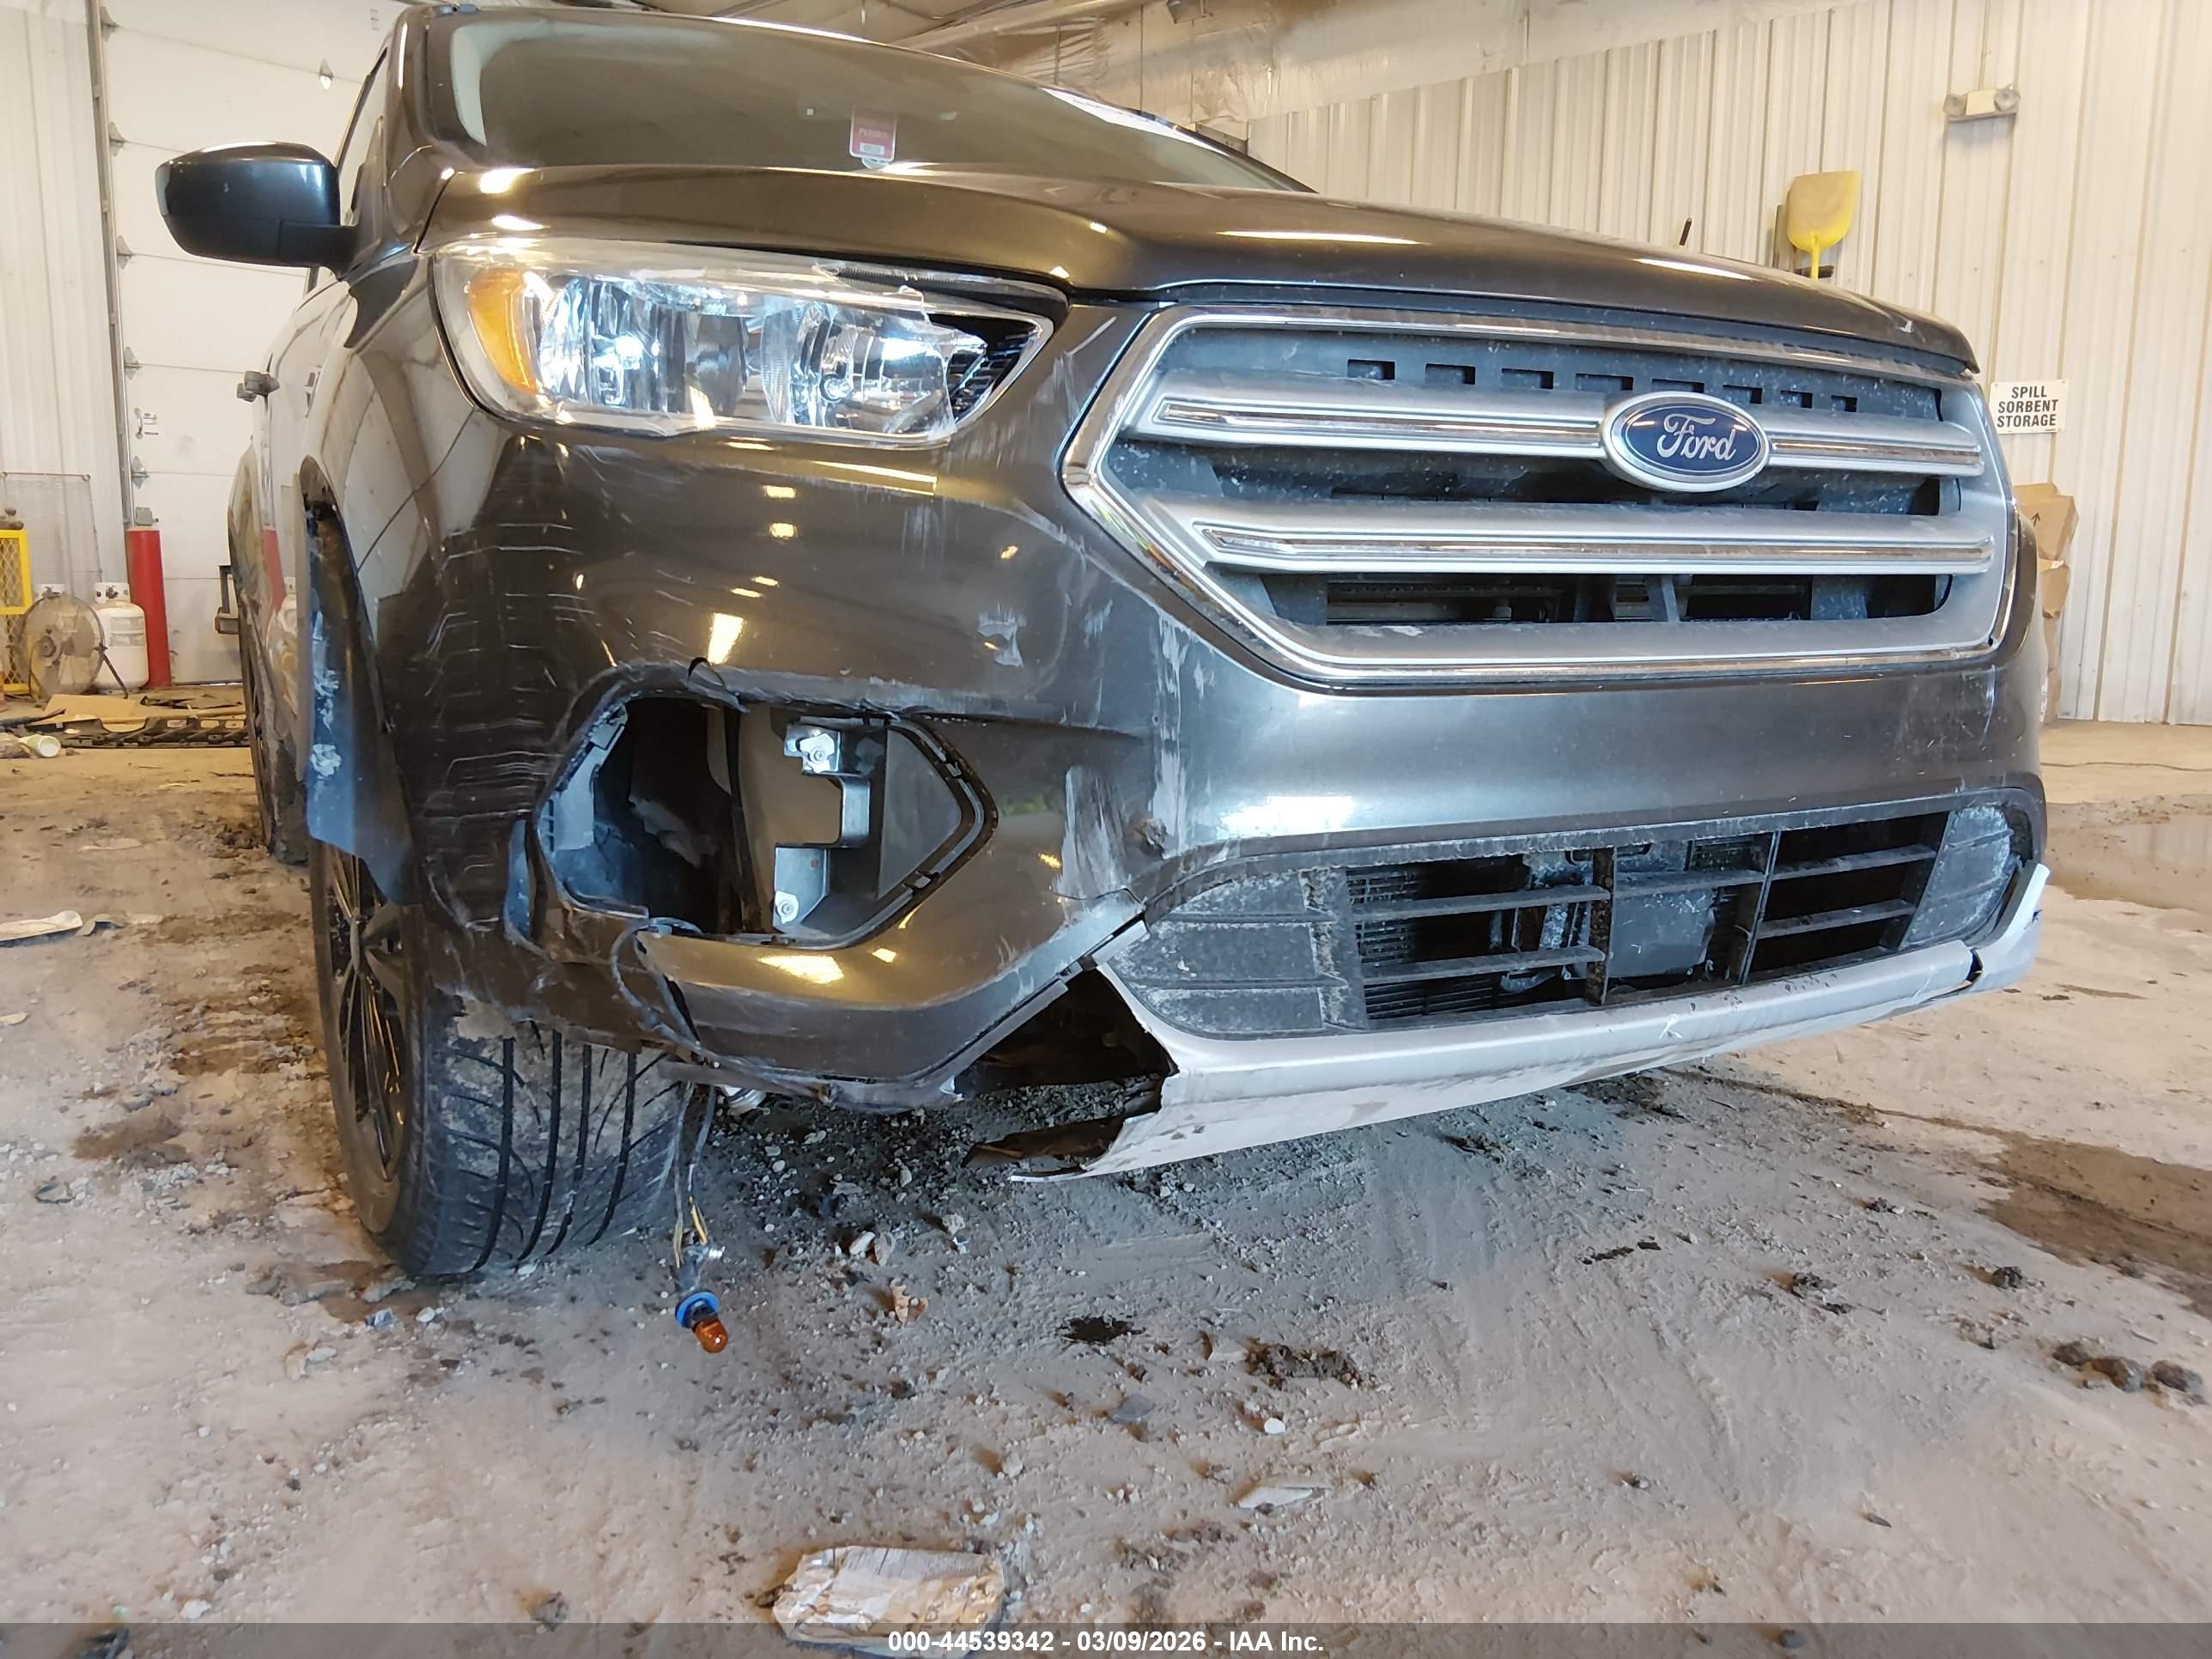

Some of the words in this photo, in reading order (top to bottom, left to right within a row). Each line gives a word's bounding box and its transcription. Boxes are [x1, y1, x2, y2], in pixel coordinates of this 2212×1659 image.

[2011, 386, 2047, 399] SPILL
[1997, 398, 2058, 414] SORBENT
[1996, 413, 2057, 428] STORAGE
[1656, 413, 1737, 461] Ford
